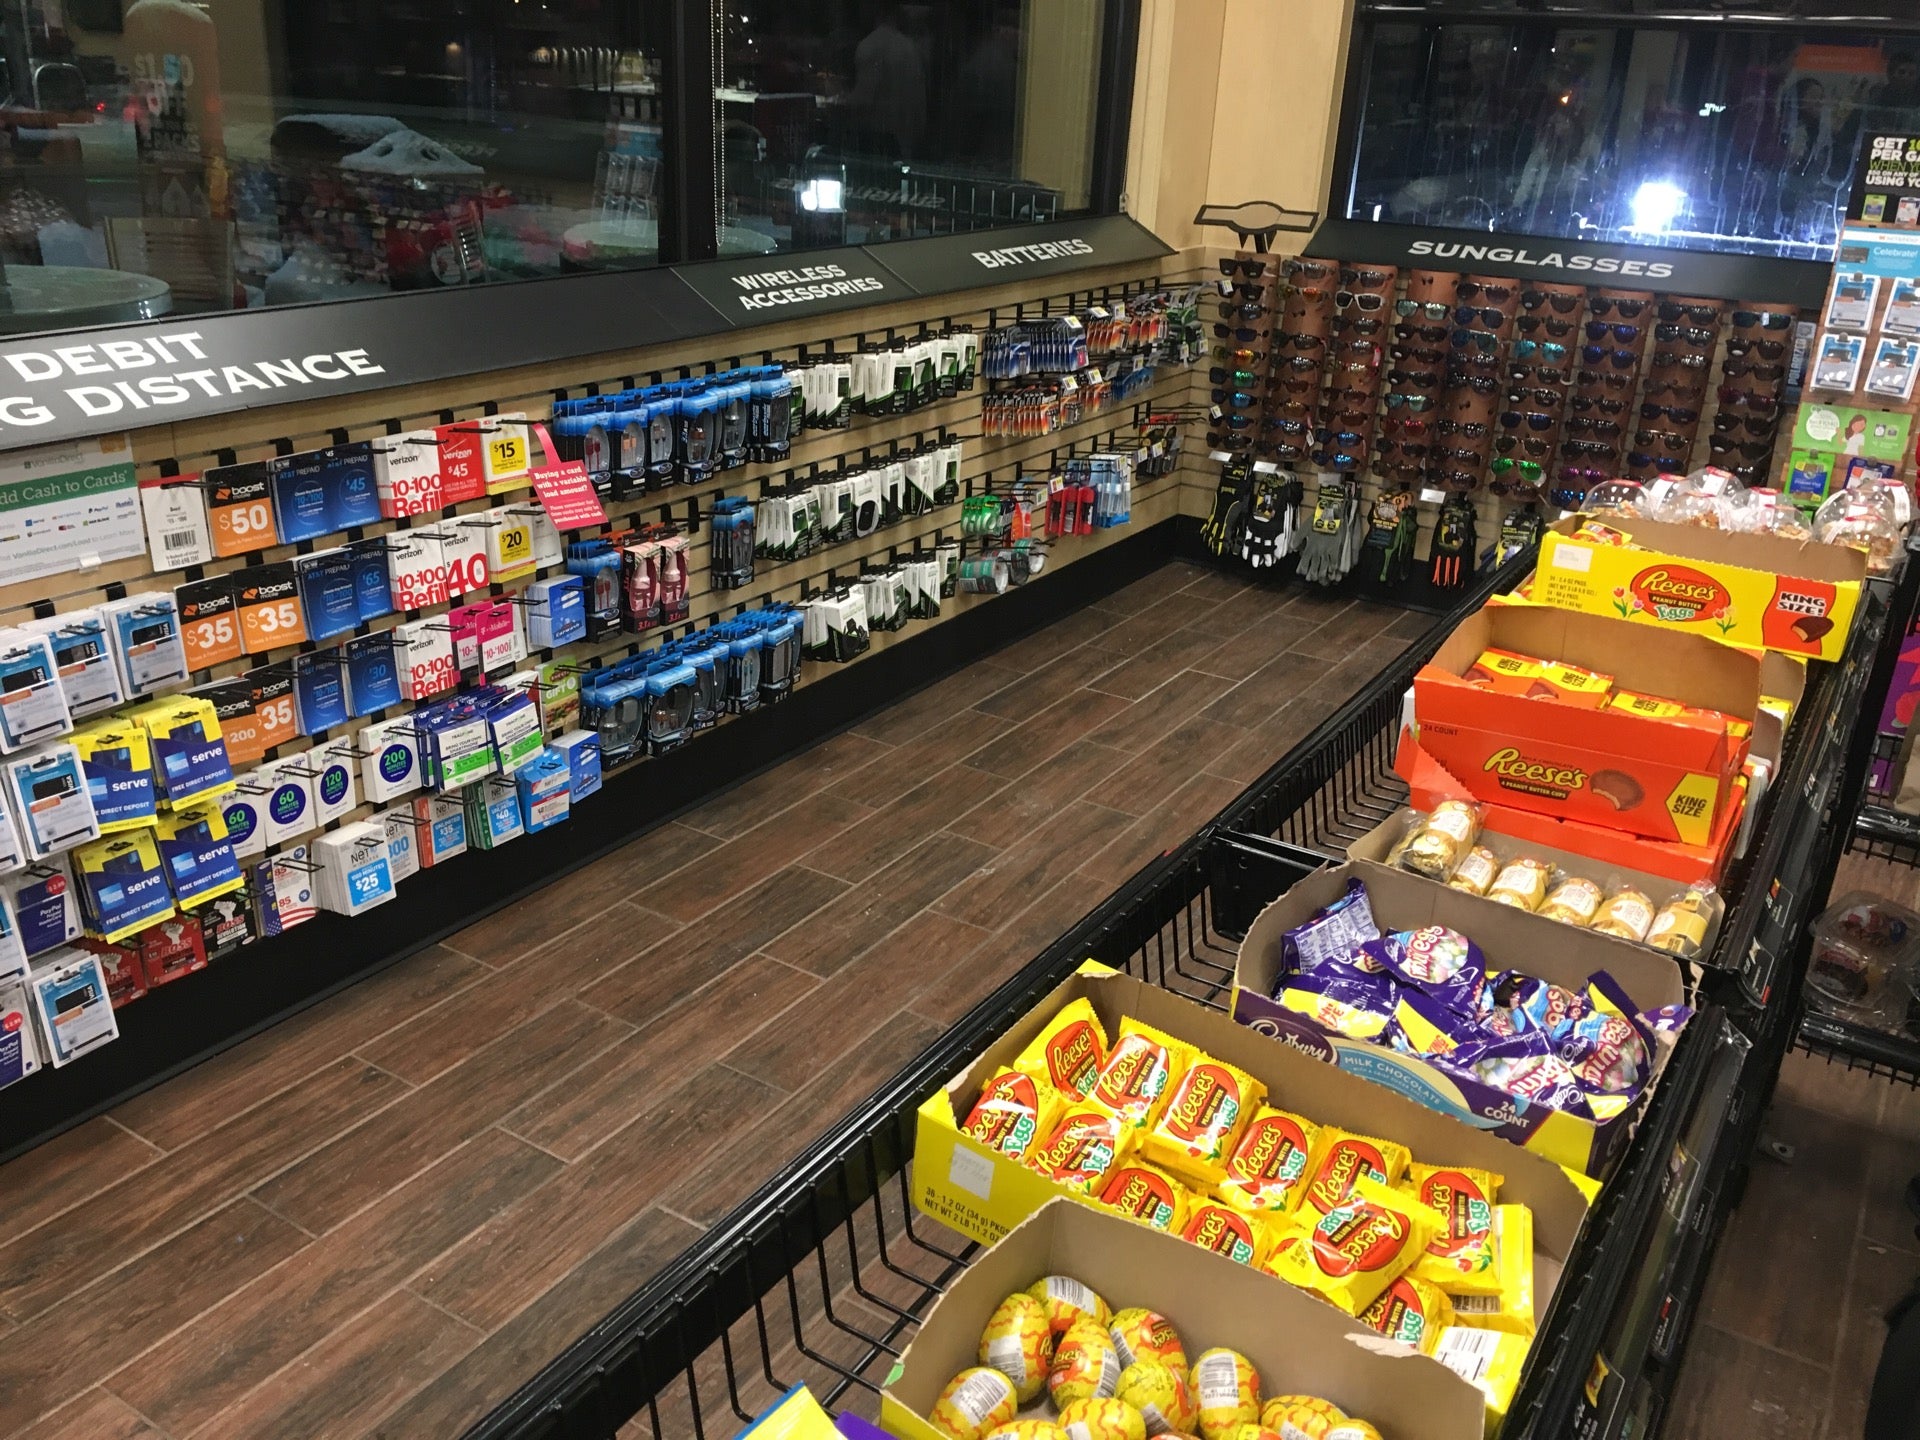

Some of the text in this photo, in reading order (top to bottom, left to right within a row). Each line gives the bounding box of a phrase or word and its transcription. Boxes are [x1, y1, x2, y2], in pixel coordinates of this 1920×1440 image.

[1873, 137, 1907, 149] GET
[1870, 160, 1906, 170] WHEN
[1871, 149, 1920, 162] PER GA
[1866, 175, 1905, 187] USING
[971, 238, 1094, 269] BATTERIES
[1408, 241, 1674, 278] SUNGLASSES
[732, 264, 846, 291] WIRELESS
[739, 276, 884, 311] ACCESSORIES
[3, 331, 208, 383] DEBIT
[64, 348, 386, 418] DISTANCE
[443, 449, 473, 460] verizon
[494, 441, 516, 460] $15
[390, 455, 418, 466] verizon
[448, 463, 468, 478] $45
[534, 471, 559, 481] Buying
[567, 466, 583, 475] card
[0, 471, 128, 505] dd Cash to Cards
[232, 482, 265, 496] boost
[537, 481, 553, 490] with
[559, 476, 588, 486] variable
[543, 484, 588, 498] load amount?
[393, 491, 442, 518] Refill
[219, 504, 268, 534] $50
[444, 537, 470, 548] verizon
[502, 531, 522, 549] $20
[395, 549, 422, 560] verizon
[447, 553, 490, 597] $40
[258, 581, 293, 595] boost
[1641, 571, 1719, 602] Reese's
[198, 595, 230, 611] boost
[400, 586, 449, 611] Refill
[1651, 595, 1703, 611] PEANUT BUTTER
[1780, 591, 1826, 607] KING
[246, 603, 298, 632] $35
[1656, 604, 1696, 622] Eggs
[1777, 601, 1825, 617] SIZE!
[186, 617, 233, 648] $35
[408, 639, 435, 652] verizon
[263, 679, 290, 694] boost
[412, 676, 456, 699] Refill
[546, 683, 566, 699] GIFT
[230, 728, 256, 743] 200
[1424, 724, 1459, 736] 24 COUNT
[192, 747, 223, 764] serve
[383, 749, 406, 766] 200
[1483, 747, 1589, 789] Reese's
[112, 777, 148, 792] serve
[171, 768, 227, 793] FREE DIRECT DEPOSIT
[325, 771, 342, 787] 120
[279, 790, 295, 804] 60
[1506, 781, 1567, 799] PEANUT BUTTER CUPS
[100, 802, 150, 816] DIRECT DEPOSIT
[1671, 803, 1703, 818] SIZE
[1675, 793, 1708, 809] KING
[229, 810, 246, 825] 60
[198, 844, 230, 863] serve
[127, 874, 161, 895] serve
[180, 866, 235, 892] FREE DIRECT DEPOSIT
[355, 872, 379, 892] $25
[106, 896, 165, 925] FREE DIRECT DEPOSIT
[1054, 1027, 1092, 1081] Reese's
[1129, 1057, 1154, 1096] PEANUT BUTTER
[1344, 1056, 1373, 1068] MILK
[1376, 1062, 1441, 1106] CHOCOLATE
[1171, 1070, 1215, 1132] Reese's
[1201, 1088, 1224, 1125] PEANUT BUTTER
[1500, 1101, 1516, 1114] 24
[1484, 1105, 1530, 1129] COUNT
[1003, 1114, 1035, 1154] Egg
[1035, 1119, 1089, 1174] Reese's
[1233, 1124, 1282, 1184] Reese's
[1266, 1141, 1292, 1178] PEANUT BUTTER
[1313, 1146, 1358, 1207] Reese's
[924, 1198, 939, 1211] NET
[940, 1206, 952, 1218] WT
[953, 1213, 959, 1222] 2
[960, 1217, 970, 1227] LB
[989, 1232, 1000, 1242] OZ
[955, 1202, 966, 1212] OZ
[967, 1207, 979, 1221] (34
[1457, 1194, 1467, 1237] PEANUT BUTTER
[1467, 1198, 1491, 1234] Egg
[1339, 1208, 1403, 1265] Reese's
[1396, 1308, 1424, 1345] Egg
